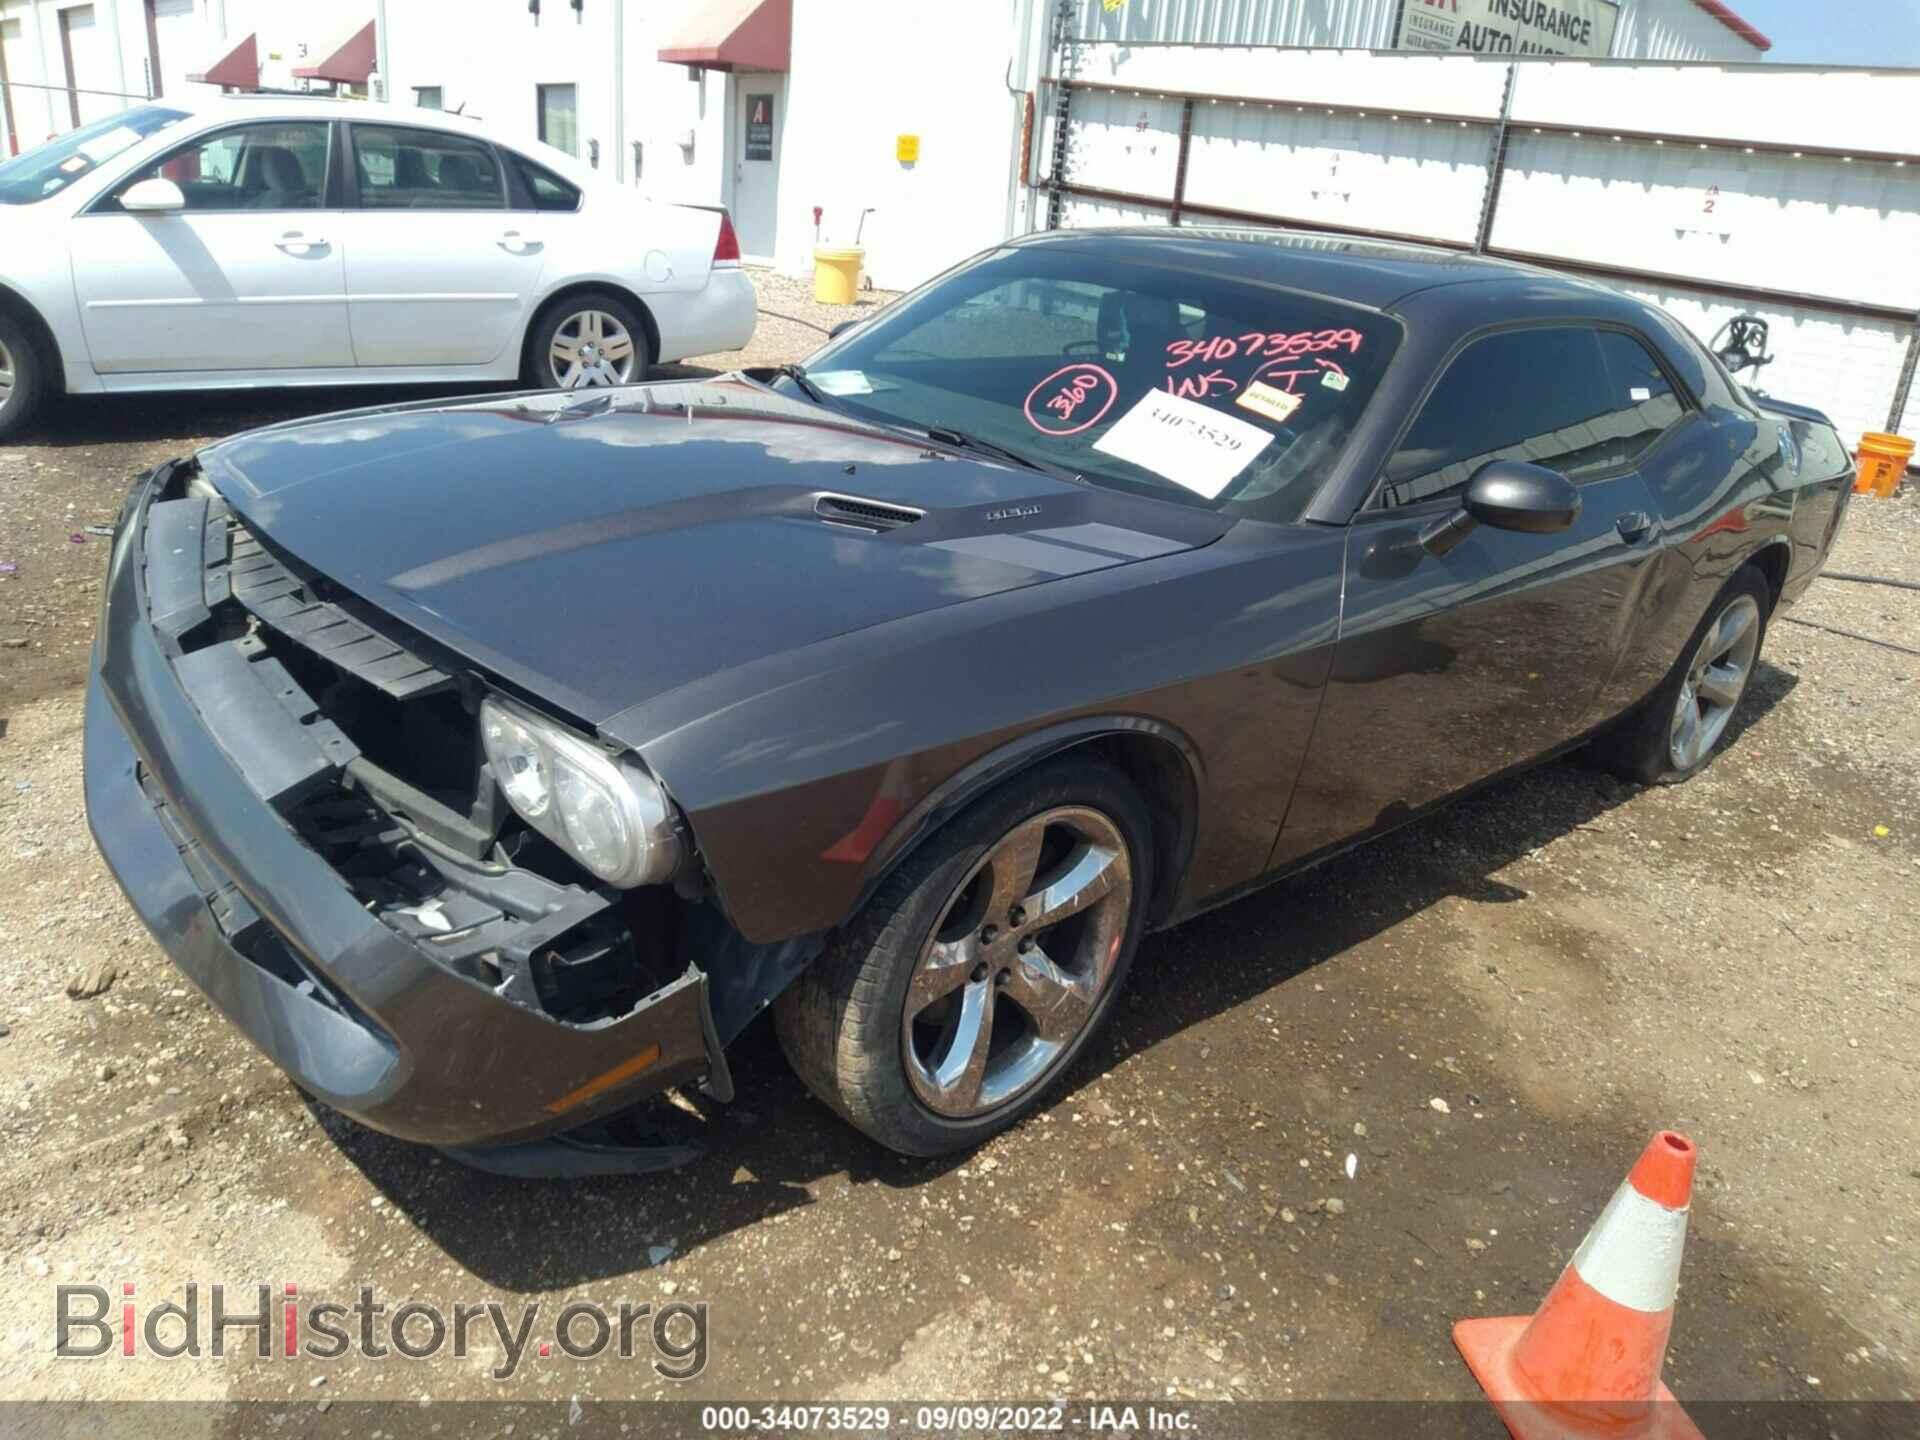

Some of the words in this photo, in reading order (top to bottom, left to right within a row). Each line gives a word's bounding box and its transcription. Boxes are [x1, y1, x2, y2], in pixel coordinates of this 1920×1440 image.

[1456, 20, 1513, 53] AUTO
[1166, 328, 1362, 367] 34073529
[1046, 374, 1099, 420] 360
